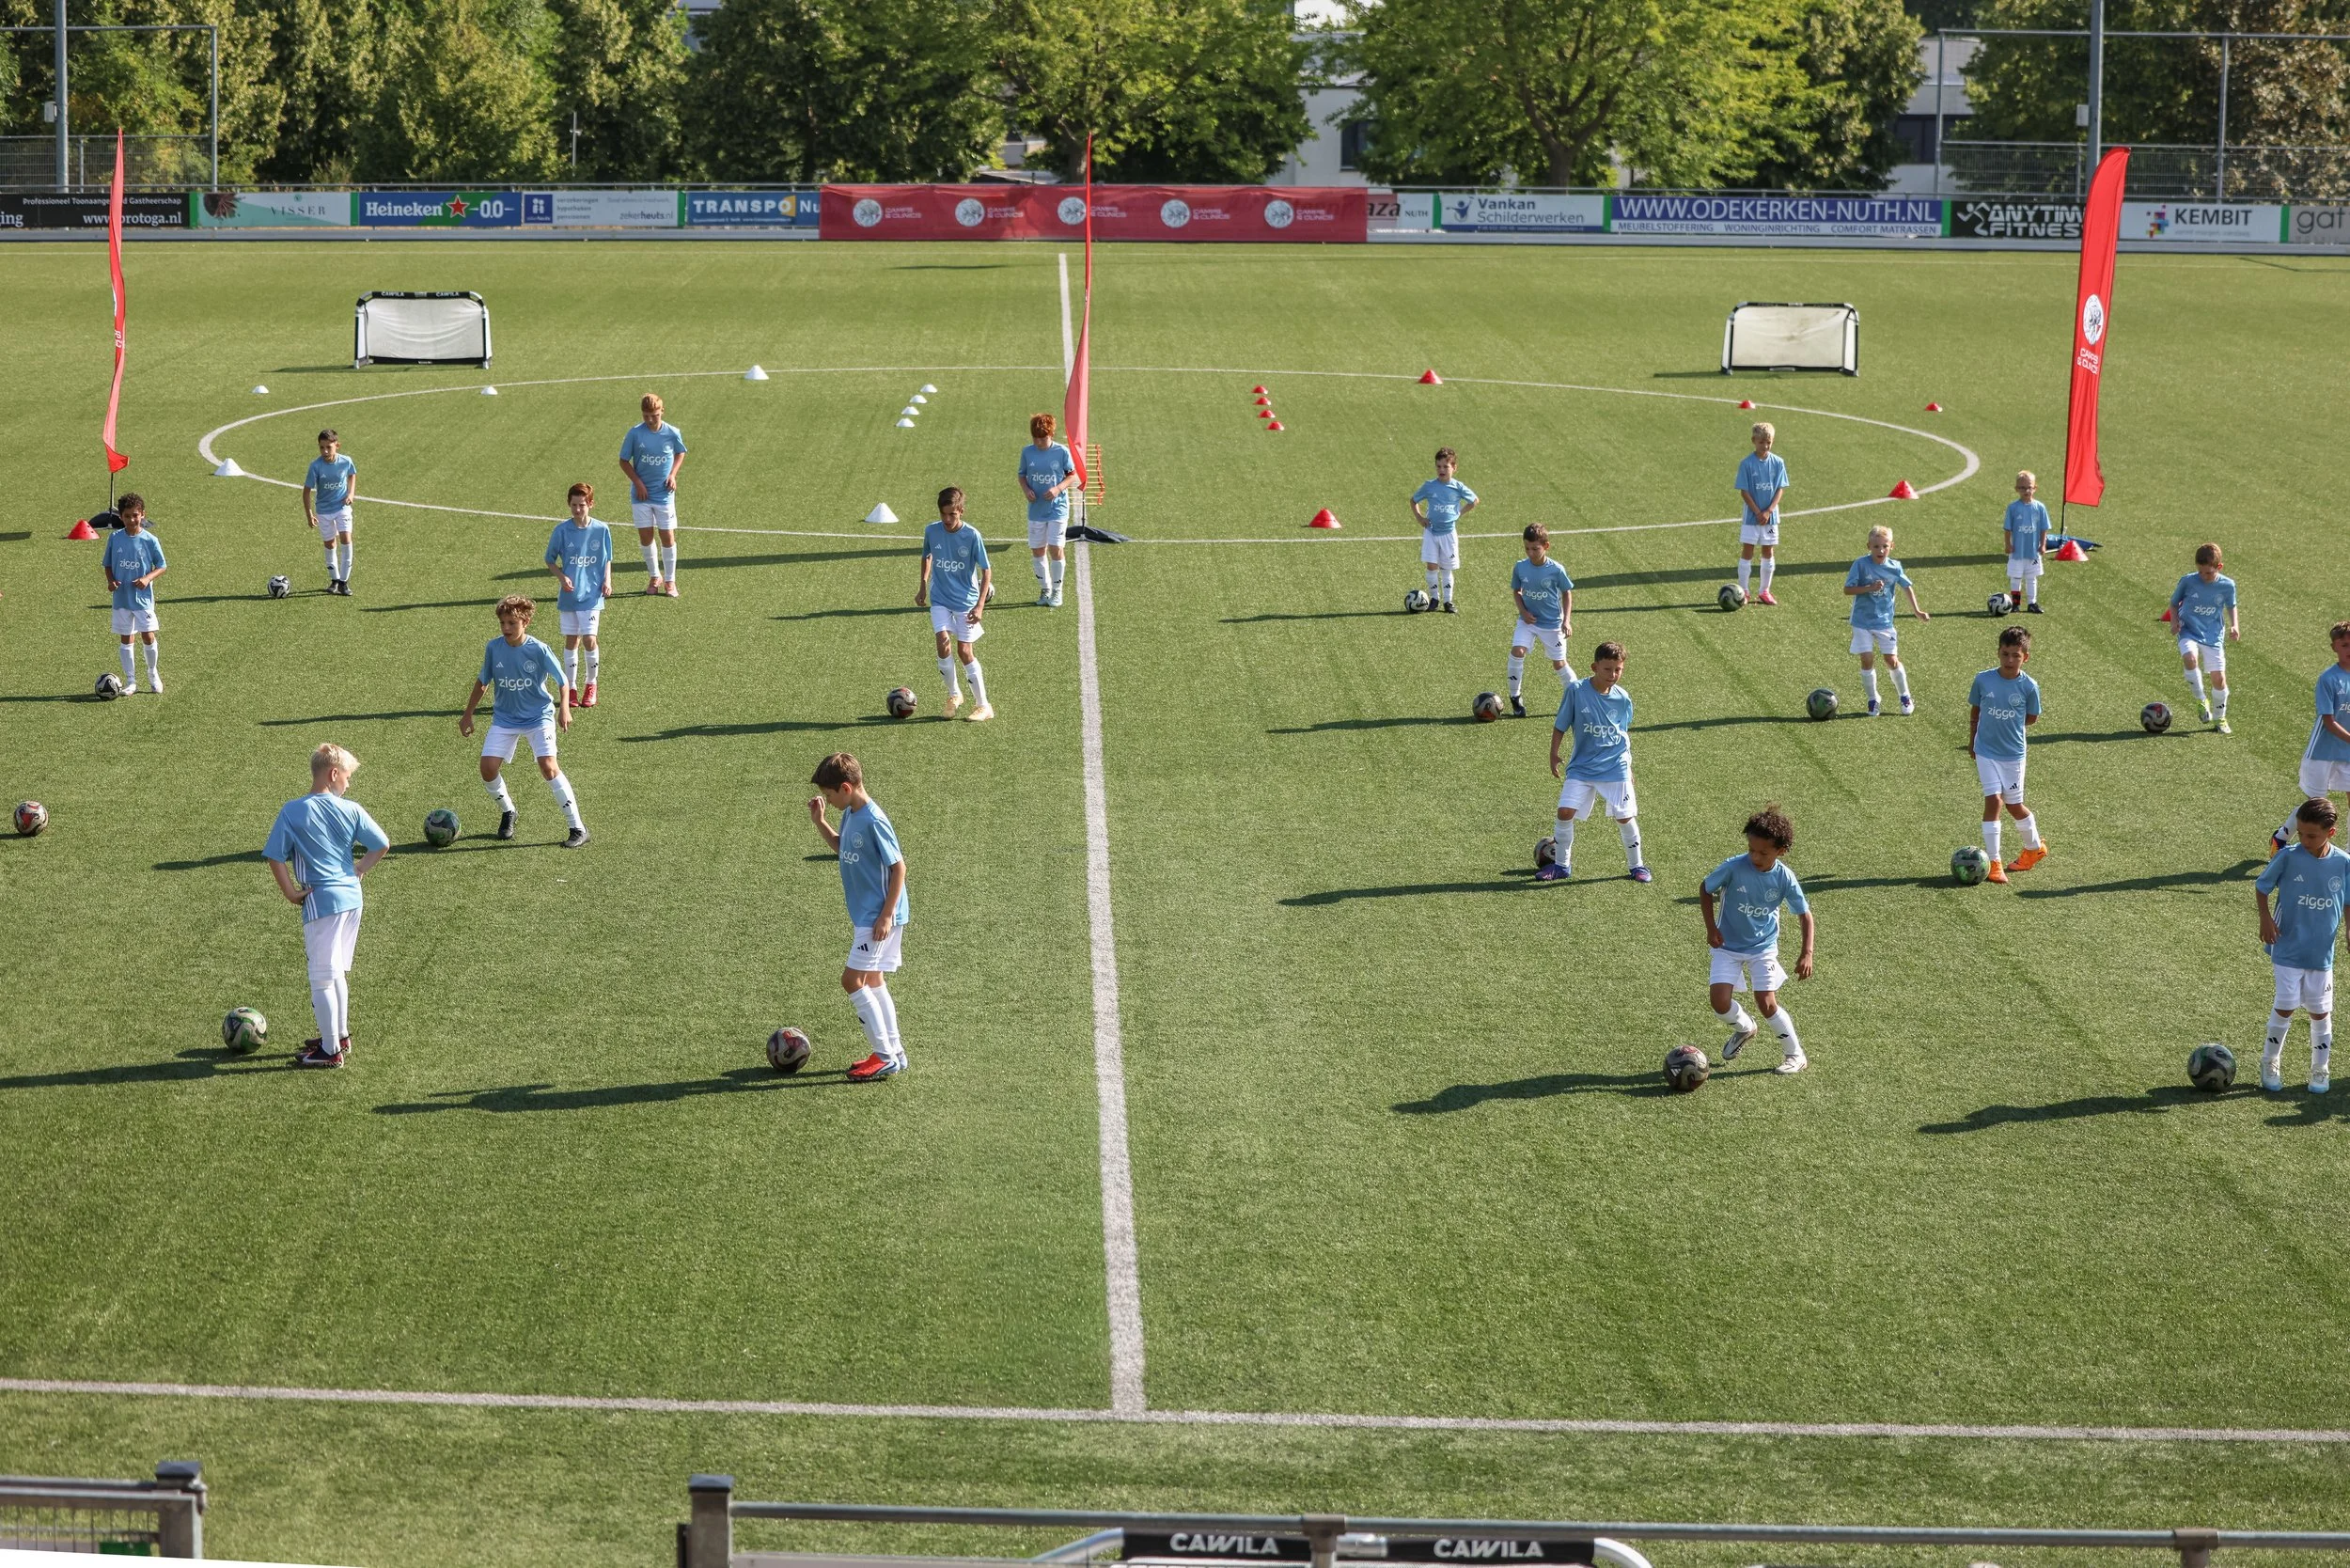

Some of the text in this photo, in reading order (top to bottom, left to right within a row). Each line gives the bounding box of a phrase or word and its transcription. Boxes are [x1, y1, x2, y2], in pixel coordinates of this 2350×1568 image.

[23, 197, 181, 206] Professioneel Toonaanged Gastheerschap
[693, 199, 791, 213] TRANSPO
[1478, 198, 1536, 210] Vankan
[270, 206, 326, 215] VISSER
[366, 202, 443, 217] Heineken
[1404, 210, 1429, 218] NUTH
[1620, 199, 1936, 222] WWW.ODEKERKEN-NUTH.NL
[1987, 204, 2085, 223] ANYTIM
[2174, 208, 2252, 225] KEMBIT
[83, 212, 181, 227] wwwrotoga.nl
[1478, 211, 1584, 224] Schilderwerken
[2296, 207, 2350, 234] gat
[1618, 222, 1936, 234] MEUBELSTOFFERING WONINGINRICHTING COMFORT MATRASSEN
[1989, 223, 2084, 237] FITNES
[641, 453, 667, 465] ziggo
[1031, 473, 1057, 484] ziggo
[1756, 481, 1773, 491] zigg
[119, 559, 140, 571] ziggo
[570, 555, 597, 567] ziggo
[936, 557, 965, 572] ziggo
[1527, 589, 1547, 600] ziggo
[2193, 604, 2216, 616] ziggo
[498, 676, 533, 691] ziggo
[1986, 706, 2014, 720] ziggo
[1583, 722, 1615, 738] ziggo
[2297, 894, 2333, 910] ziggo
[1737, 902, 1769, 917] ziggo
[1169, 1532, 1280, 1555] CAWILA
[1433, 1538, 1544, 1558] CAWILA
